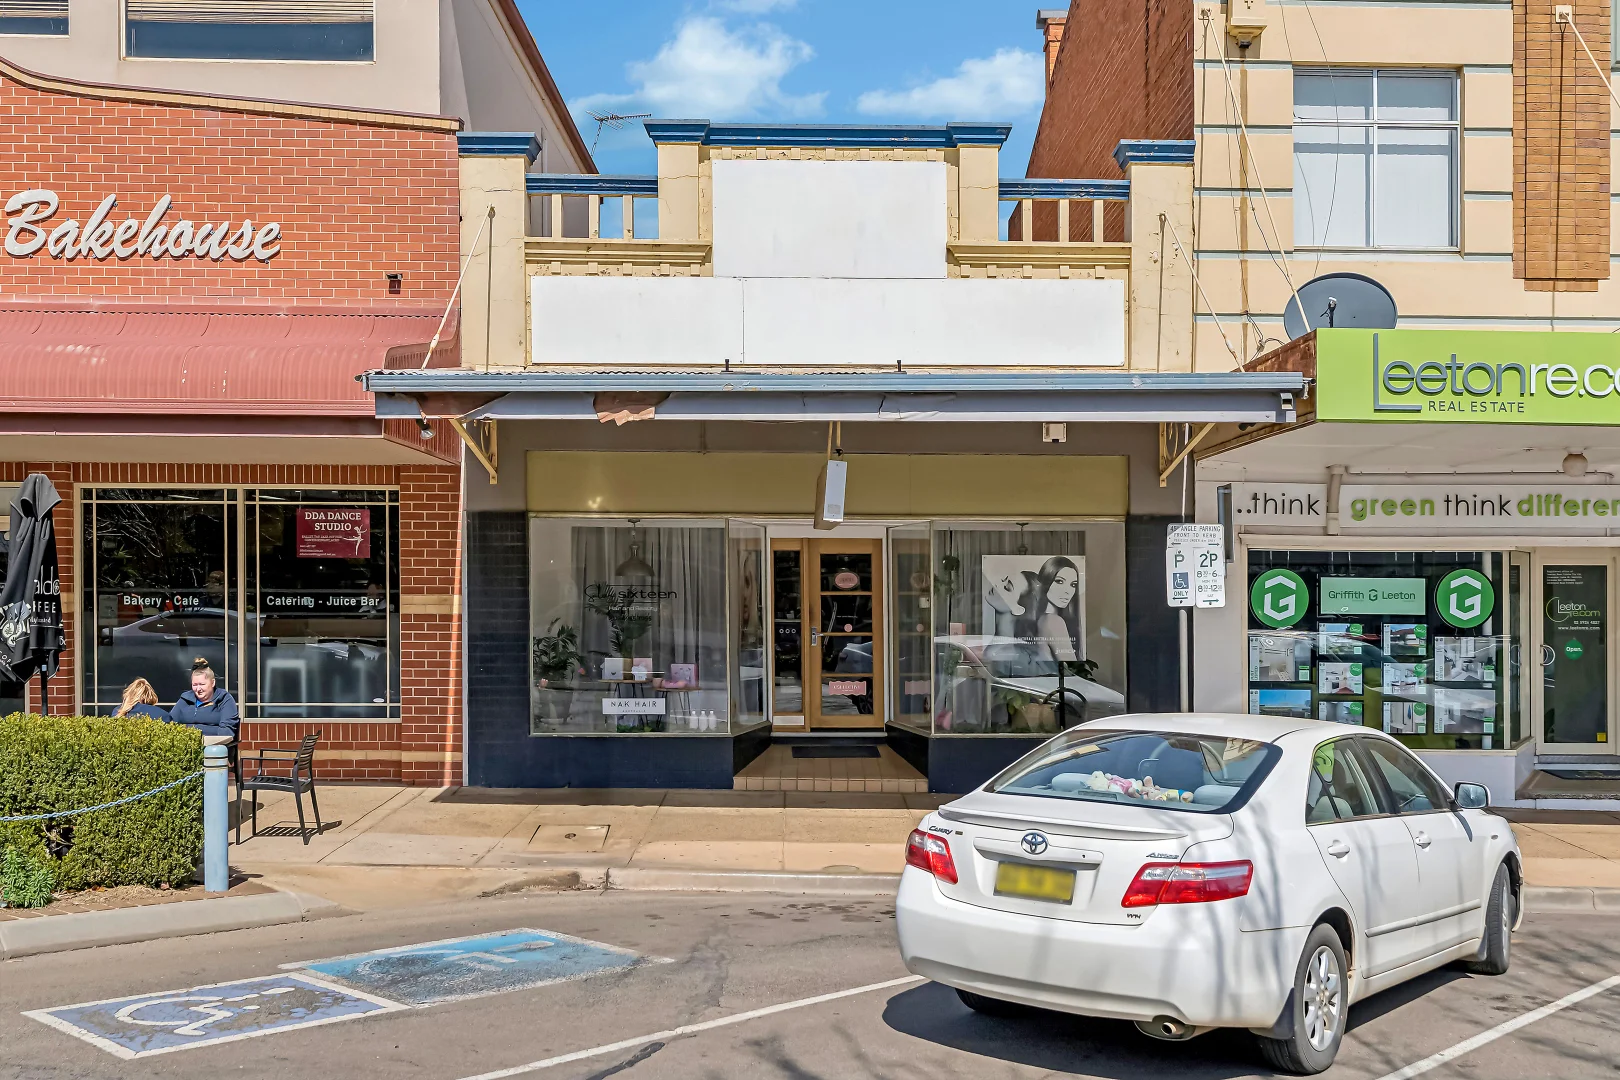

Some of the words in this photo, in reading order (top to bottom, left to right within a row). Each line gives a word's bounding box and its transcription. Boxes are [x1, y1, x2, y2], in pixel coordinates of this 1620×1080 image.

[5, 189, 281, 261] Bakehouse
[1373, 333, 1620, 413] Leetonre.c
[1428, 401, 1464, 412] REAL
[1470, 401, 1524, 412] ESTATE
[1350, 494, 1435, 521] green
[1444, 494, 1511, 516] think
[305, 512, 326, 520] DDA
[328, 512, 362, 521] DANCE
[315, 522, 352, 531] STUDIO
[1200, 525, 1221, 533] PARKING
[1175, 554, 1185, 568] P
[1200, 553, 1218, 568] 2P
[618, 588, 678, 599] sixteen
[1328, 590, 1364, 599] Griffith
[1382, 591, 1416, 600] Leeton
[123, 595, 161, 607] Bakery
[174, 595, 199, 605] Cafe
[266, 595, 314, 607] Catering
[327, 595, 357, 605] Juice
[361, 595, 380, 606] Bar
[1557, 600, 1586, 613] Leeton
[635, 700, 657, 708] HAIR
